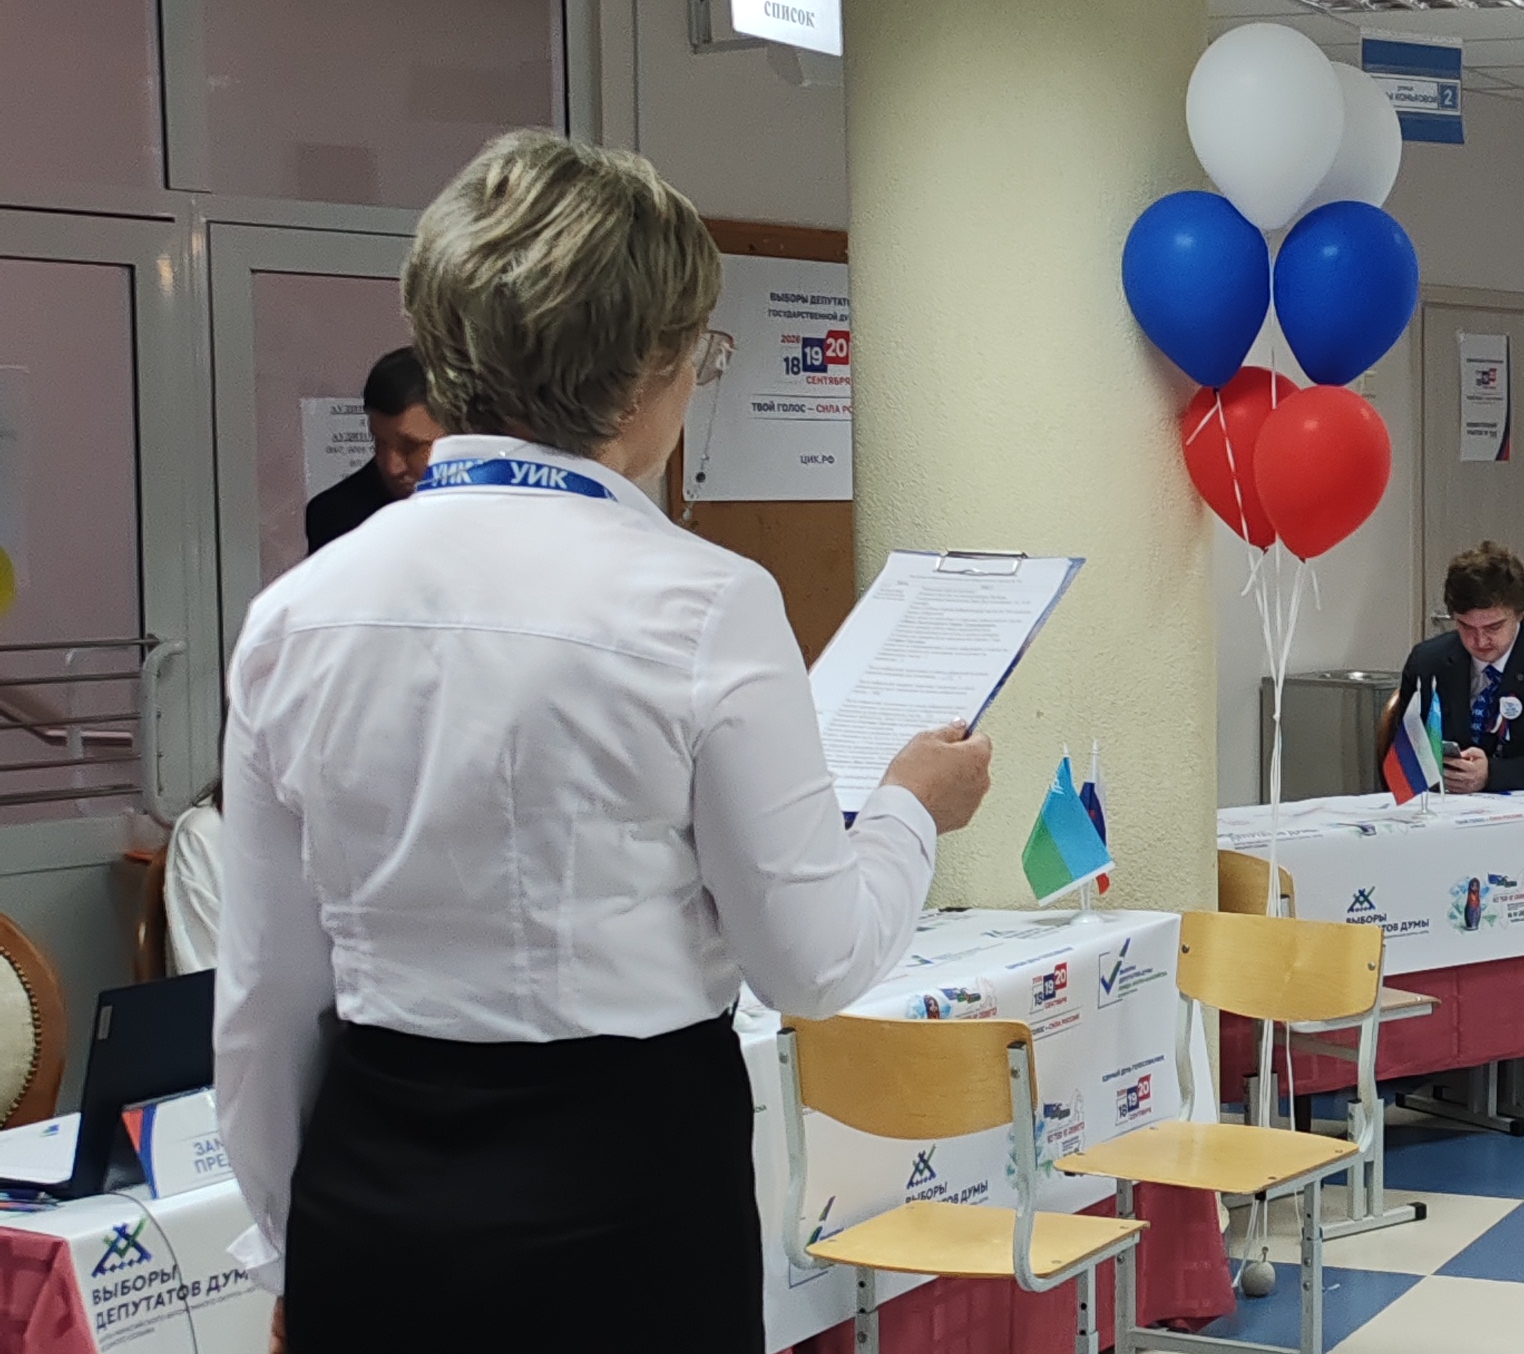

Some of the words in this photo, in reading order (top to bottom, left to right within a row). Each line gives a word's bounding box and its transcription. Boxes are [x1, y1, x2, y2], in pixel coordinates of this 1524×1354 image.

[763, 0, 816, 29] список
[1443, 88, 1453, 105] 2
[769, 292, 809, 305] ВЫБОРЫ
[809, 294, 850, 307] ДЕПУТАТ
[767, 308, 838, 322] ГОСУДАРСТВЕННОЙ
[804, 346, 823, 366] 19
[825, 337, 848, 358] 20
[783, 356, 801, 376] 18
[806, 375, 851, 386] СЕНТЯБРЯ
[751, 400, 775, 413] ТВОЙ
[777, 403, 806, 414] ГОЛОС
[816, 404, 841, 414] СИЛА
[800, 454, 835, 465] ЦИК.РФ
[432, 461, 473, 486] УИК
[510, 461, 568, 490] УИК
[1346, 913, 1387, 925] ВЫБОРЫ
[1400, 918, 1430, 932] ДУМЫ
[1055, 968, 1067, 986] 20
[1044, 979, 1054, 995] 19
[1034, 991, 1043, 1006] 18
[1138, 1081, 1150, 1098] 20
[1127, 1092, 1138, 1108] 19
[1119, 1104, 1128, 1119] 18
[193, 1137, 225, 1157] ЗАМ
[194, 1153, 230, 1174] ПРЕ
[960, 1180, 989, 1204] ДУМЫ
[92, 1263, 179, 1306] ВЫБОРЫ
[95, 1280, 202, 1332] ДЕПУТАТОВ
[206, 1268, 249, 1295] ДУМ
